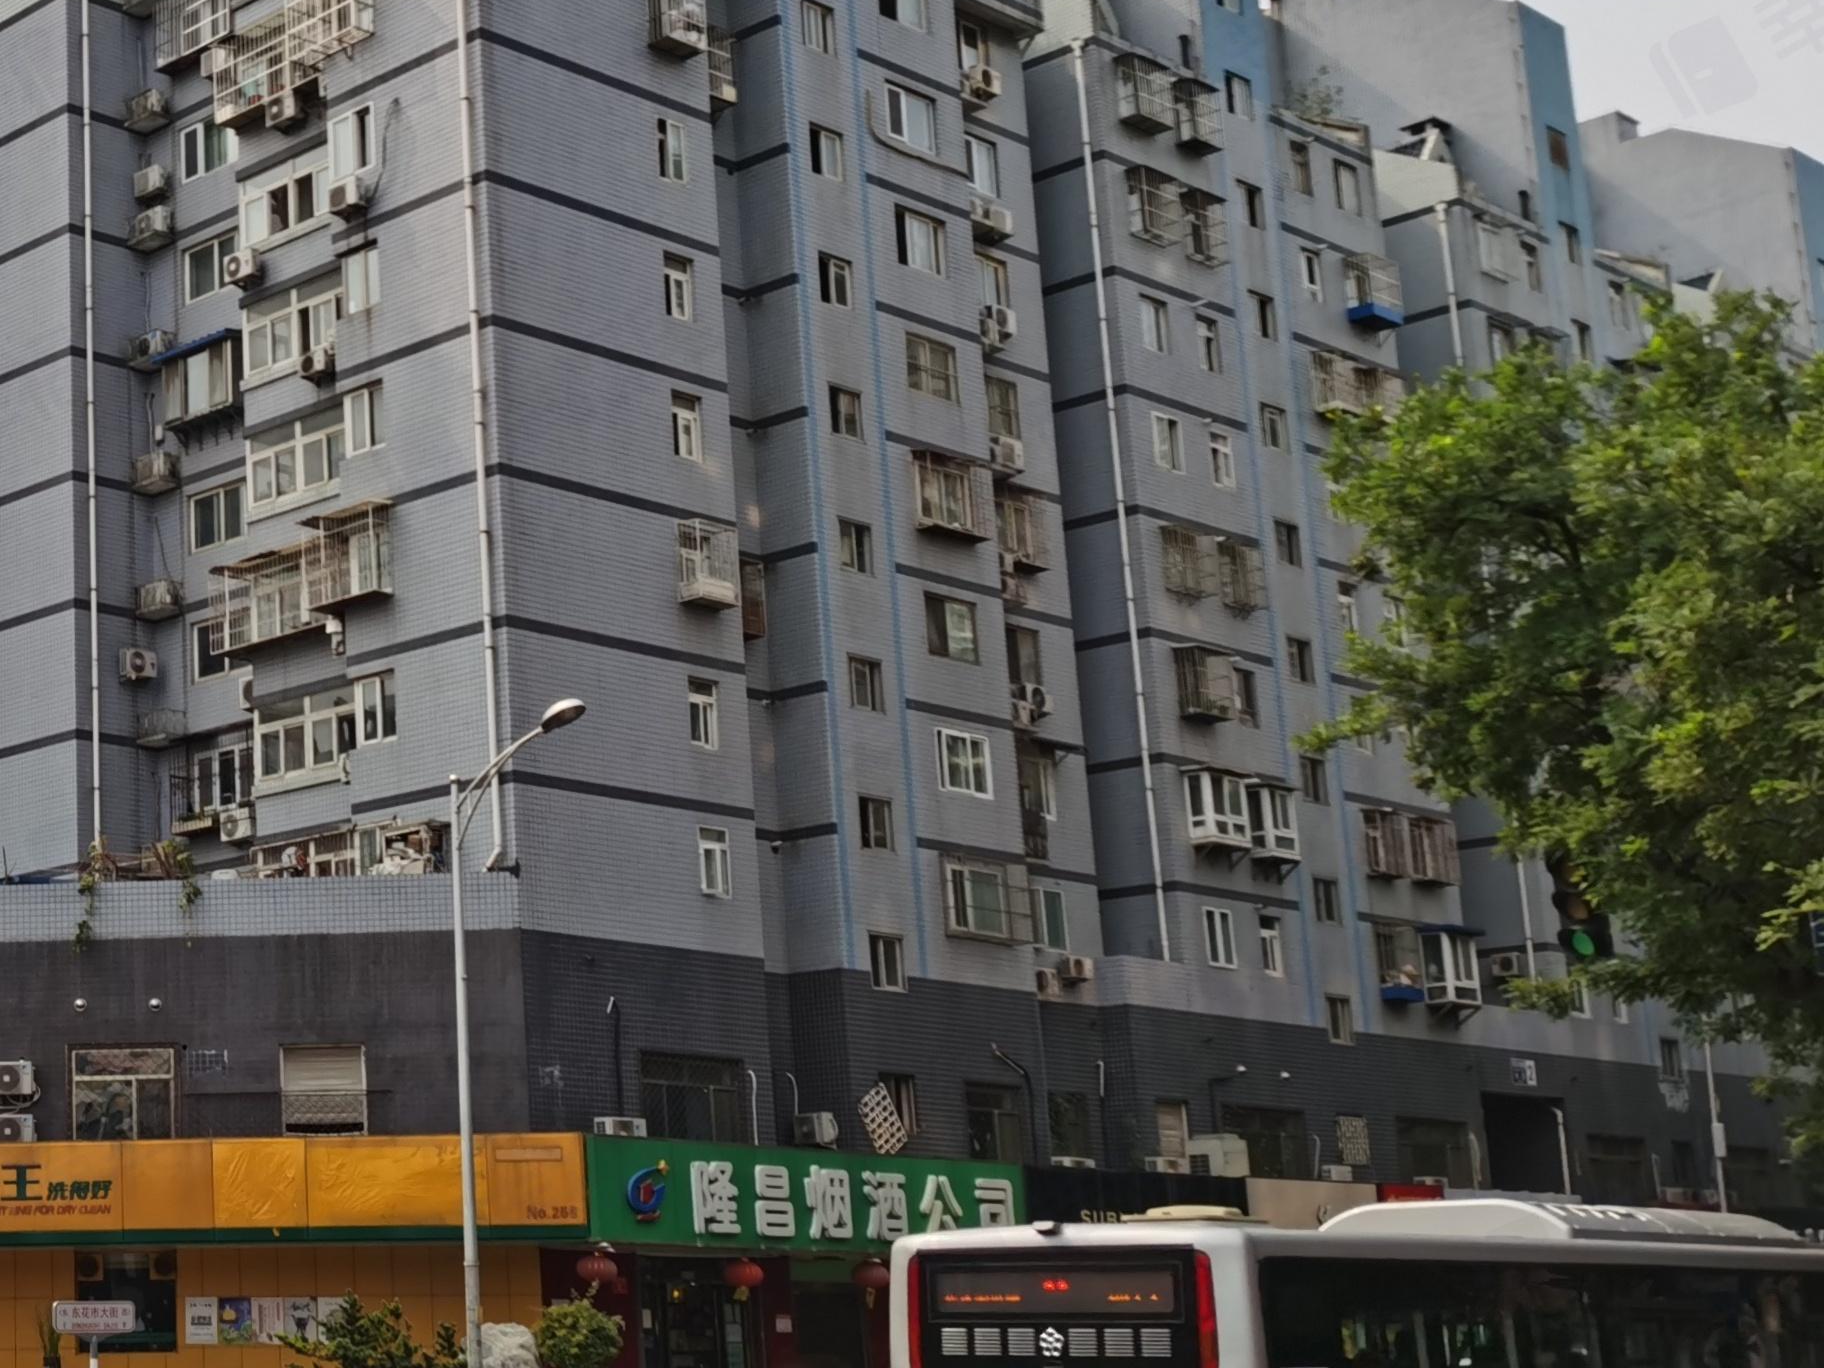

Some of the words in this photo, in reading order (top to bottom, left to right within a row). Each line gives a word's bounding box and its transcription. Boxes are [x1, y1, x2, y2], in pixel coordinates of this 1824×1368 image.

[689, 1160, 1016, 1240] 隆昌烟酒公司
